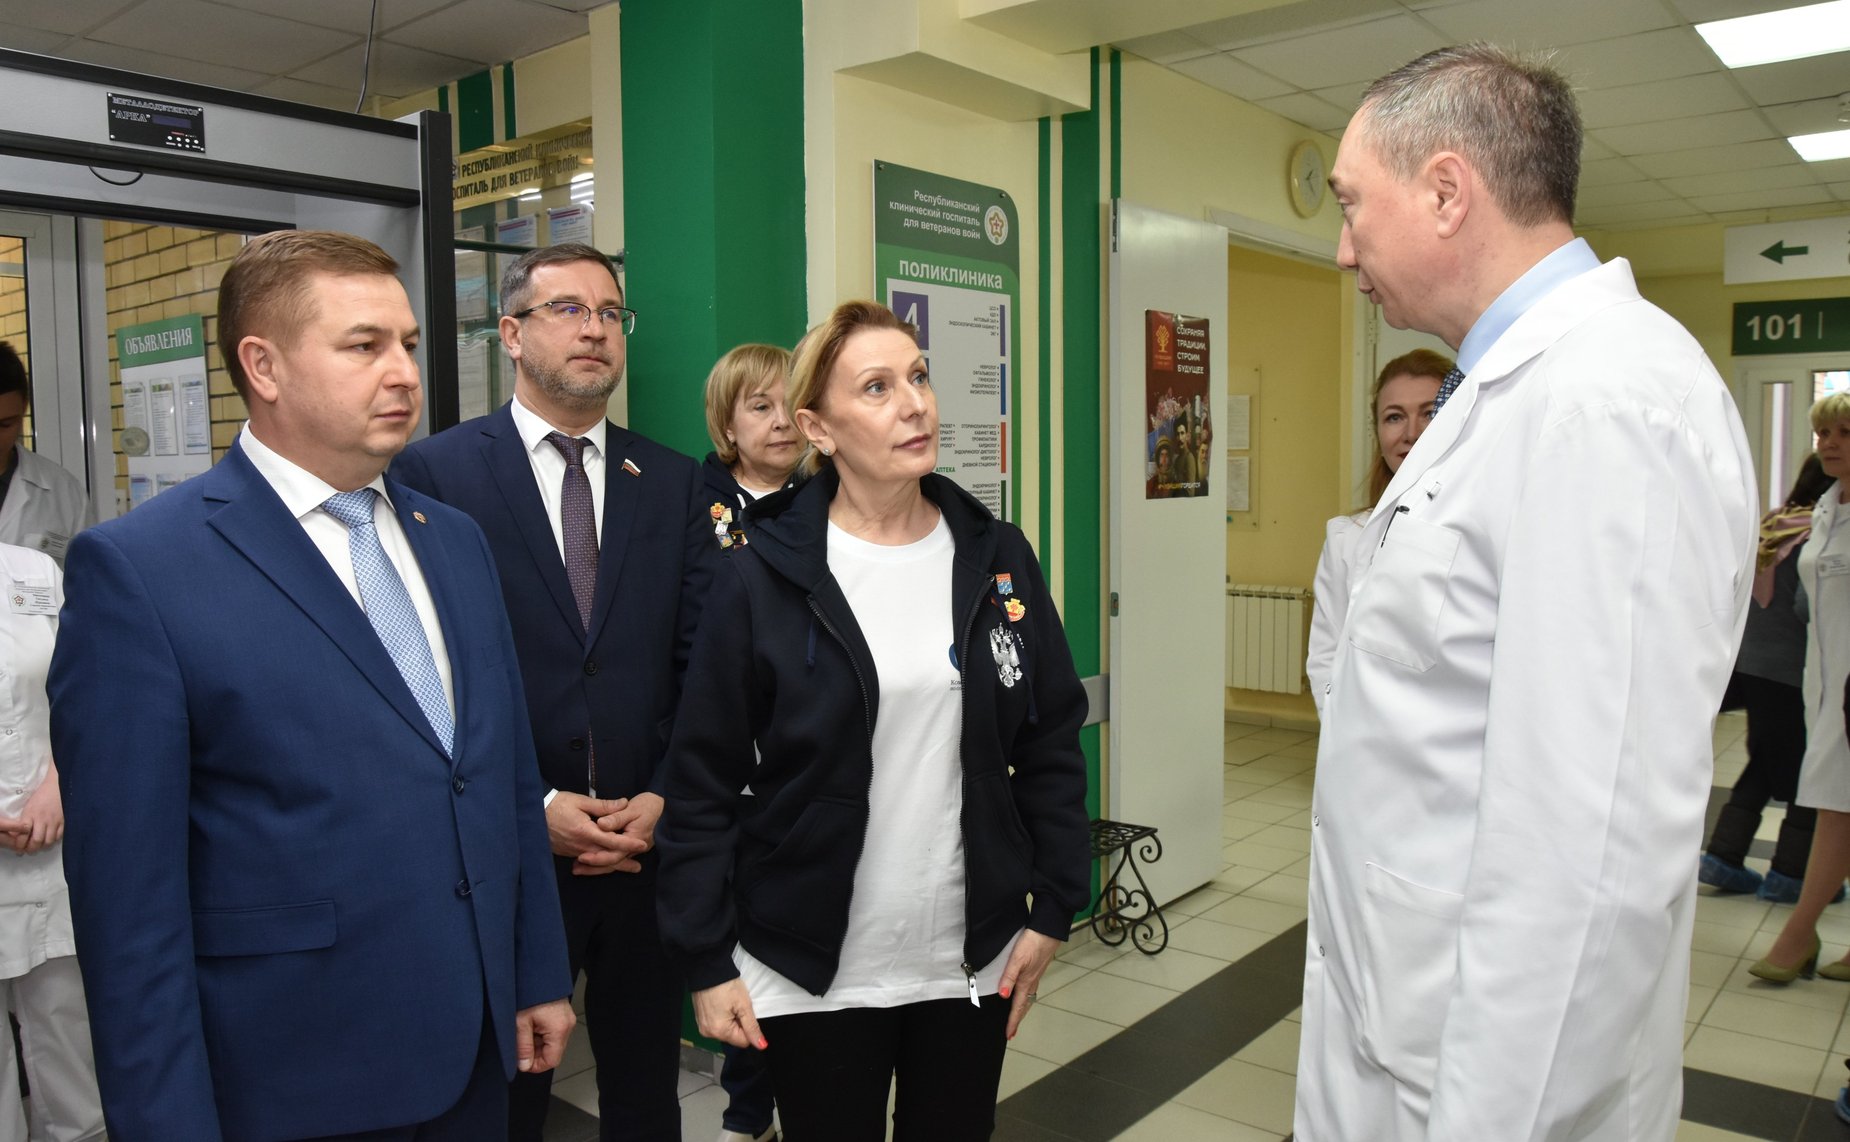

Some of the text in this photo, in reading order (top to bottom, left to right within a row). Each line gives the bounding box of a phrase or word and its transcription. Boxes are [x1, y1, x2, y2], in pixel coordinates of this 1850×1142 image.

[461, 143, 533, 178] РЕСПУБЛИКАНСКИЙ
[452, 180, 489, 200] ОСПИТАЛЬ
[491, 174, 507, 193] ДЛЯ
[889, 201, 980, 227] клинический госпиталь
[914, 190, 980, 213] Республиканский
[903, 218, 980, 239] для ветеранов войн
[904, 302, 920, 331] 4
[1746, 313, 1802, 341] 101
[125, 327, 193, 355] ОБЪЯВЛЕНИЯ
[1176, 326, 1205, 338] СОХРАНЯЯ
[1177, 352, 1200, 362] СТРОИМ
[1177, 364, 1204, 375] БУДУЩЕЕ
